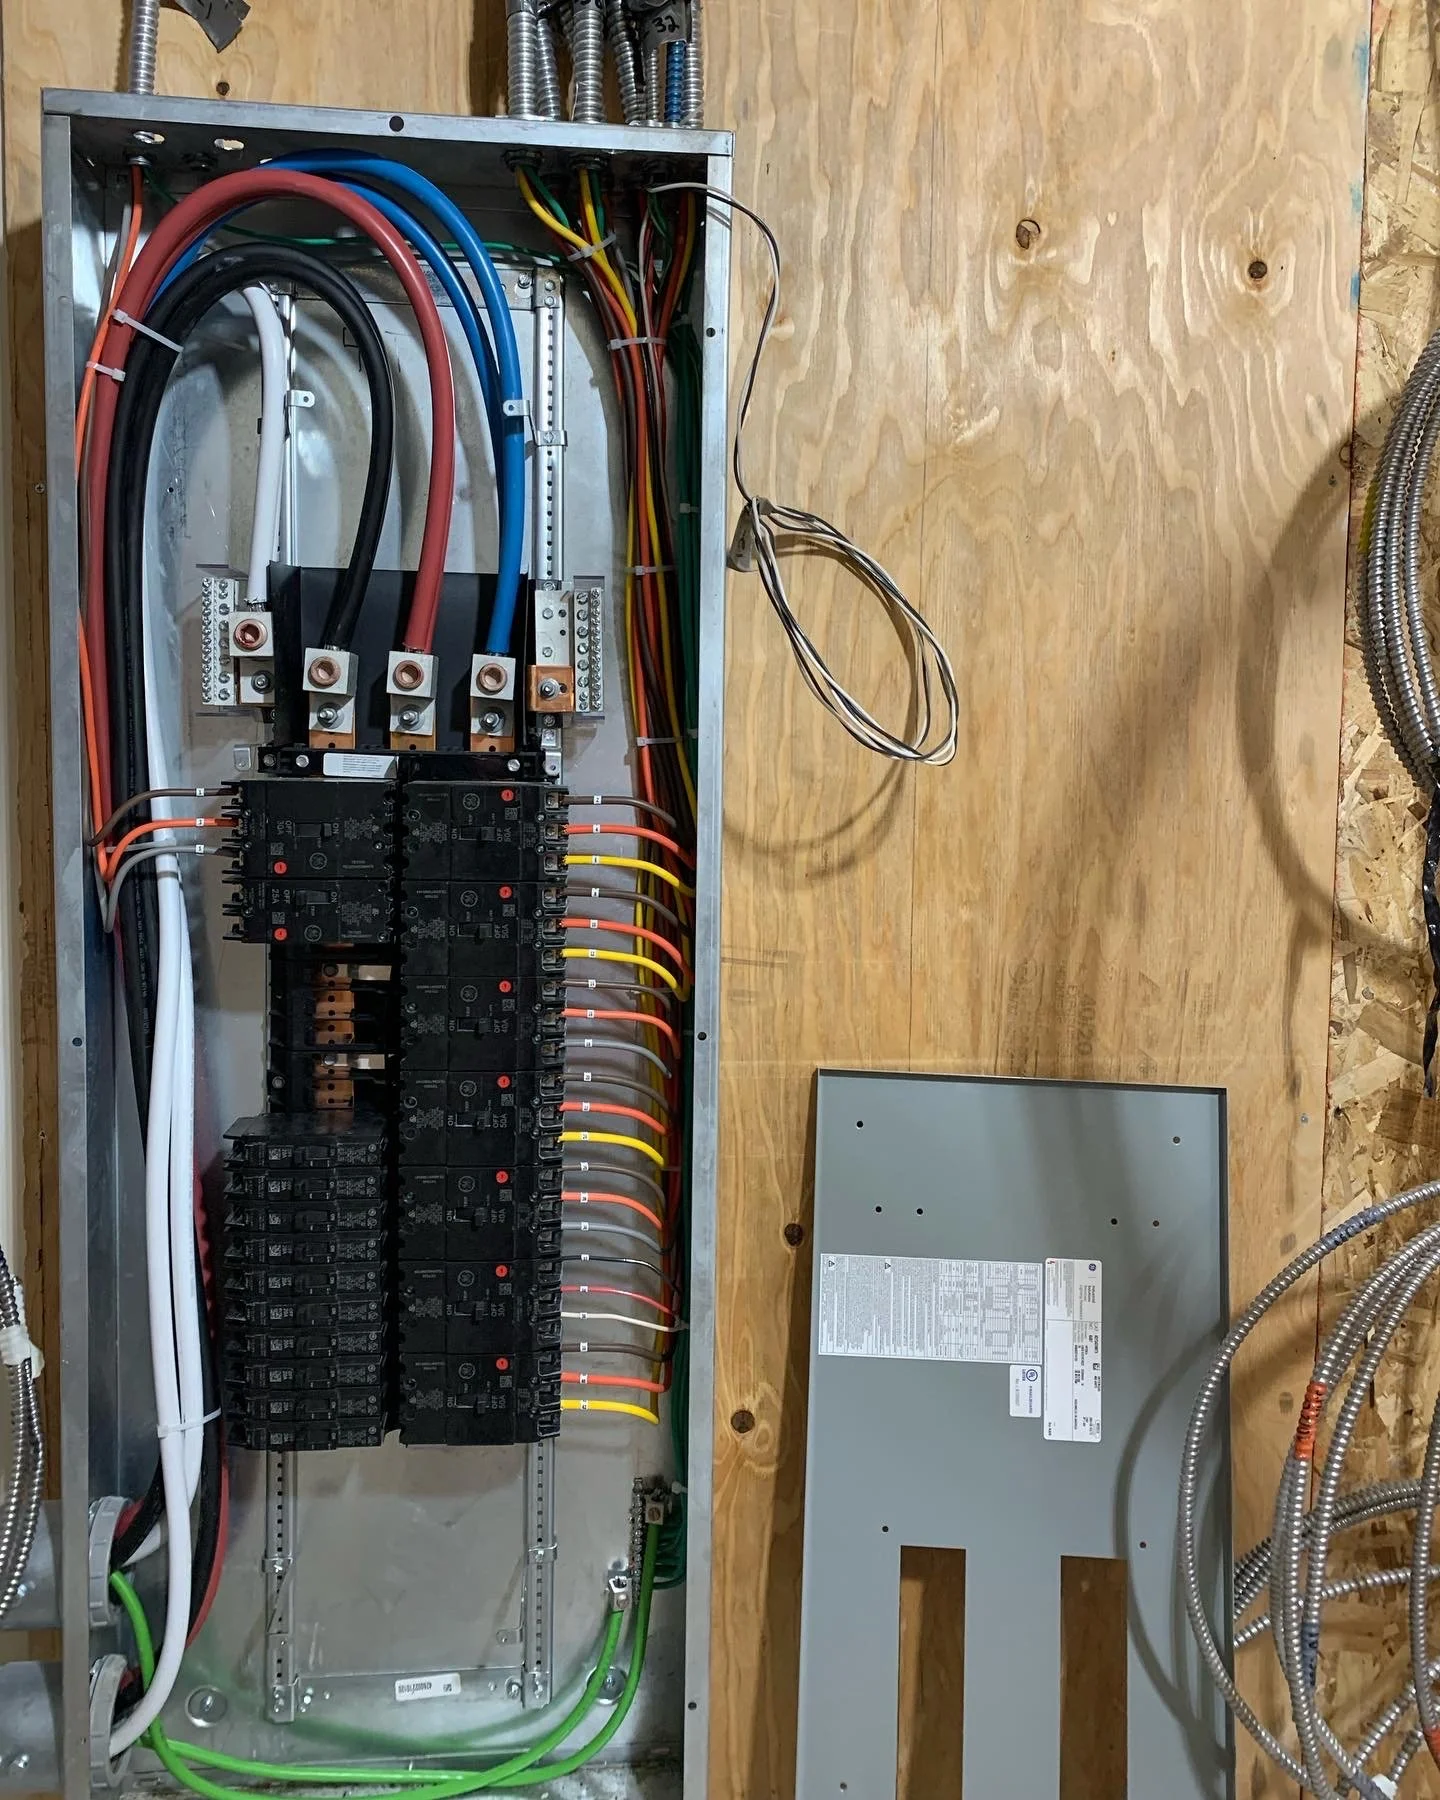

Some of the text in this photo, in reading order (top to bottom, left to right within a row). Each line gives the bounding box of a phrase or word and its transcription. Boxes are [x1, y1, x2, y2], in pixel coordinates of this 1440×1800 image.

[652, 16, 680, 33] 32
[332, 822, 339, 835] ON
[451, 827, 457, 840] ON
[271, 888, 279, 904] 25A
[331, 891, 337, 903] ON
[449, 925, 455, 937] ON
[501, 923, 509, 939] 50A
[449, 1020, 455, 1032] ON
[447, 1115, 454, 1127] ON
[446, 1210, 453, 1222] ON
[446, 1304, 453, 1316] ON
[447, 1395, 453, 1407] ON
